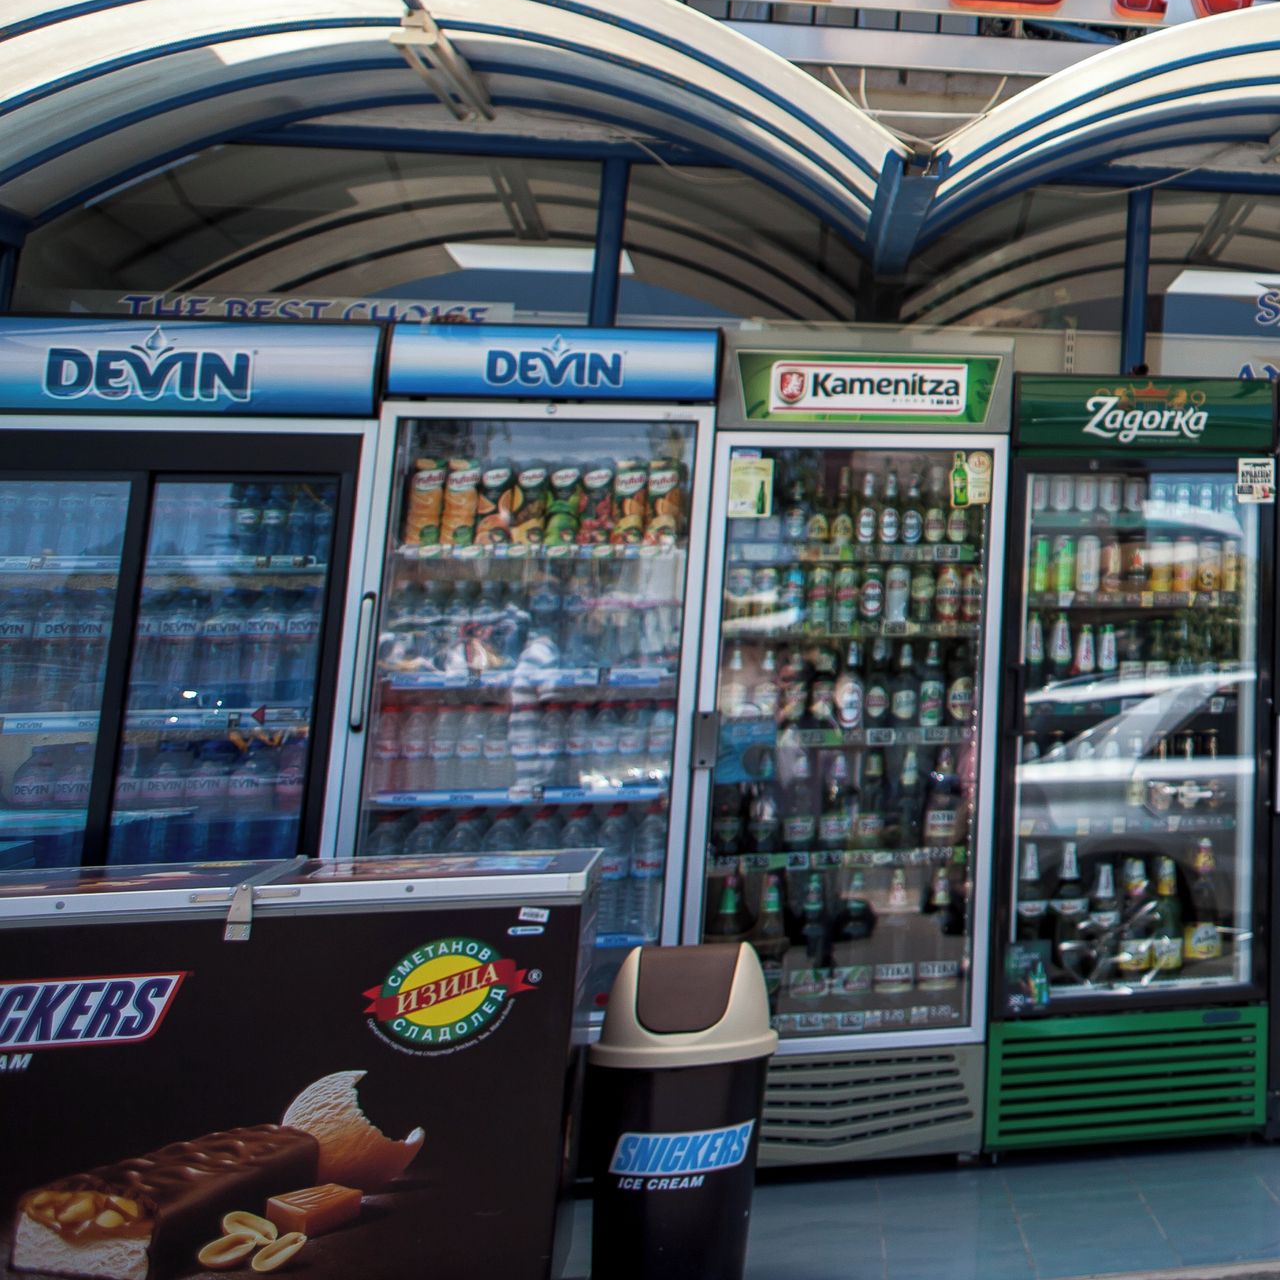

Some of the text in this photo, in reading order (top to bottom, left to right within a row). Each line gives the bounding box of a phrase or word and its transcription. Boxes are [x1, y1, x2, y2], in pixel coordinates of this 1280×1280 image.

[119, 294, 213, 316] THE
[222, 297, 334, 319] BEST
[43, 346, 252, 402] DEVIN
[483, 348, 624, 388] DEVIN
[811, 372, 961, 398] Kamenitza
[1082, 395, 1209, 444] Zagorka
[387, 941, 492, 988] СМЕТАНОВ
[0, 977, 174, 1045] CKERS
[395, 962, 500, 1016] ИЗИДА
[392, 988, 507, 1043] СЛАДОЛЕД
[613, 1124, 750, 1172] SNICKERS
[618, 1174, 705, 1191] ICE CREAM
